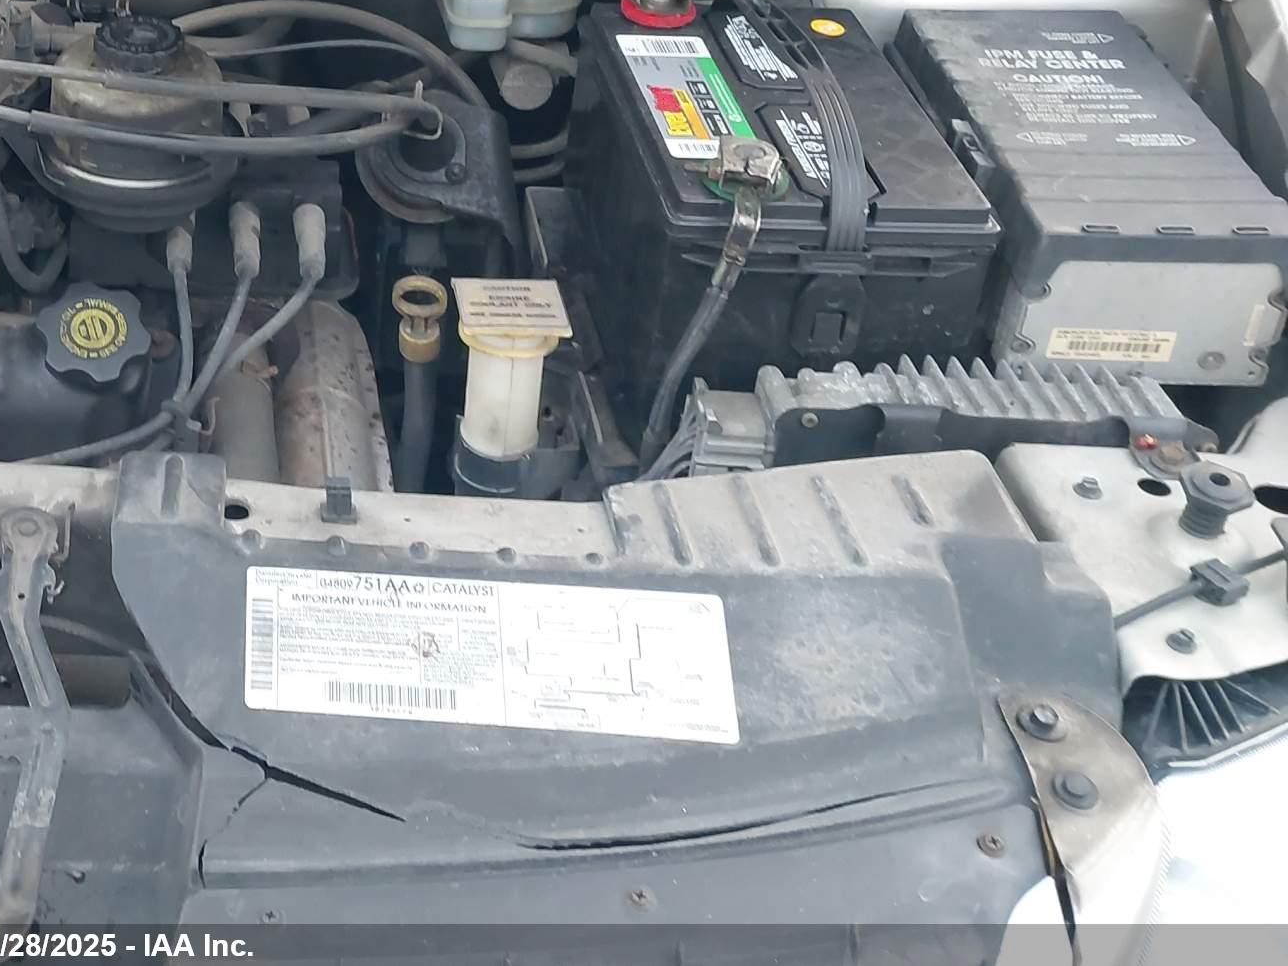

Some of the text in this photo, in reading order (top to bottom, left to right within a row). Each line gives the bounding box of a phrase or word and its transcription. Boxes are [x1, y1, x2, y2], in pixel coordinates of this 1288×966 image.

[985, 49, 1023, 60] IPM
[1027, 50, 1079, 61] FUSE
[977, 58, 1127, 70] RELAY CENTER
[1012, 73, 1105, 84] CAUTION!
[432, 581, 495, 596] CATALYST
[291, 593, 488, 614] IMPORTANT VEHICLE INFORMATION
